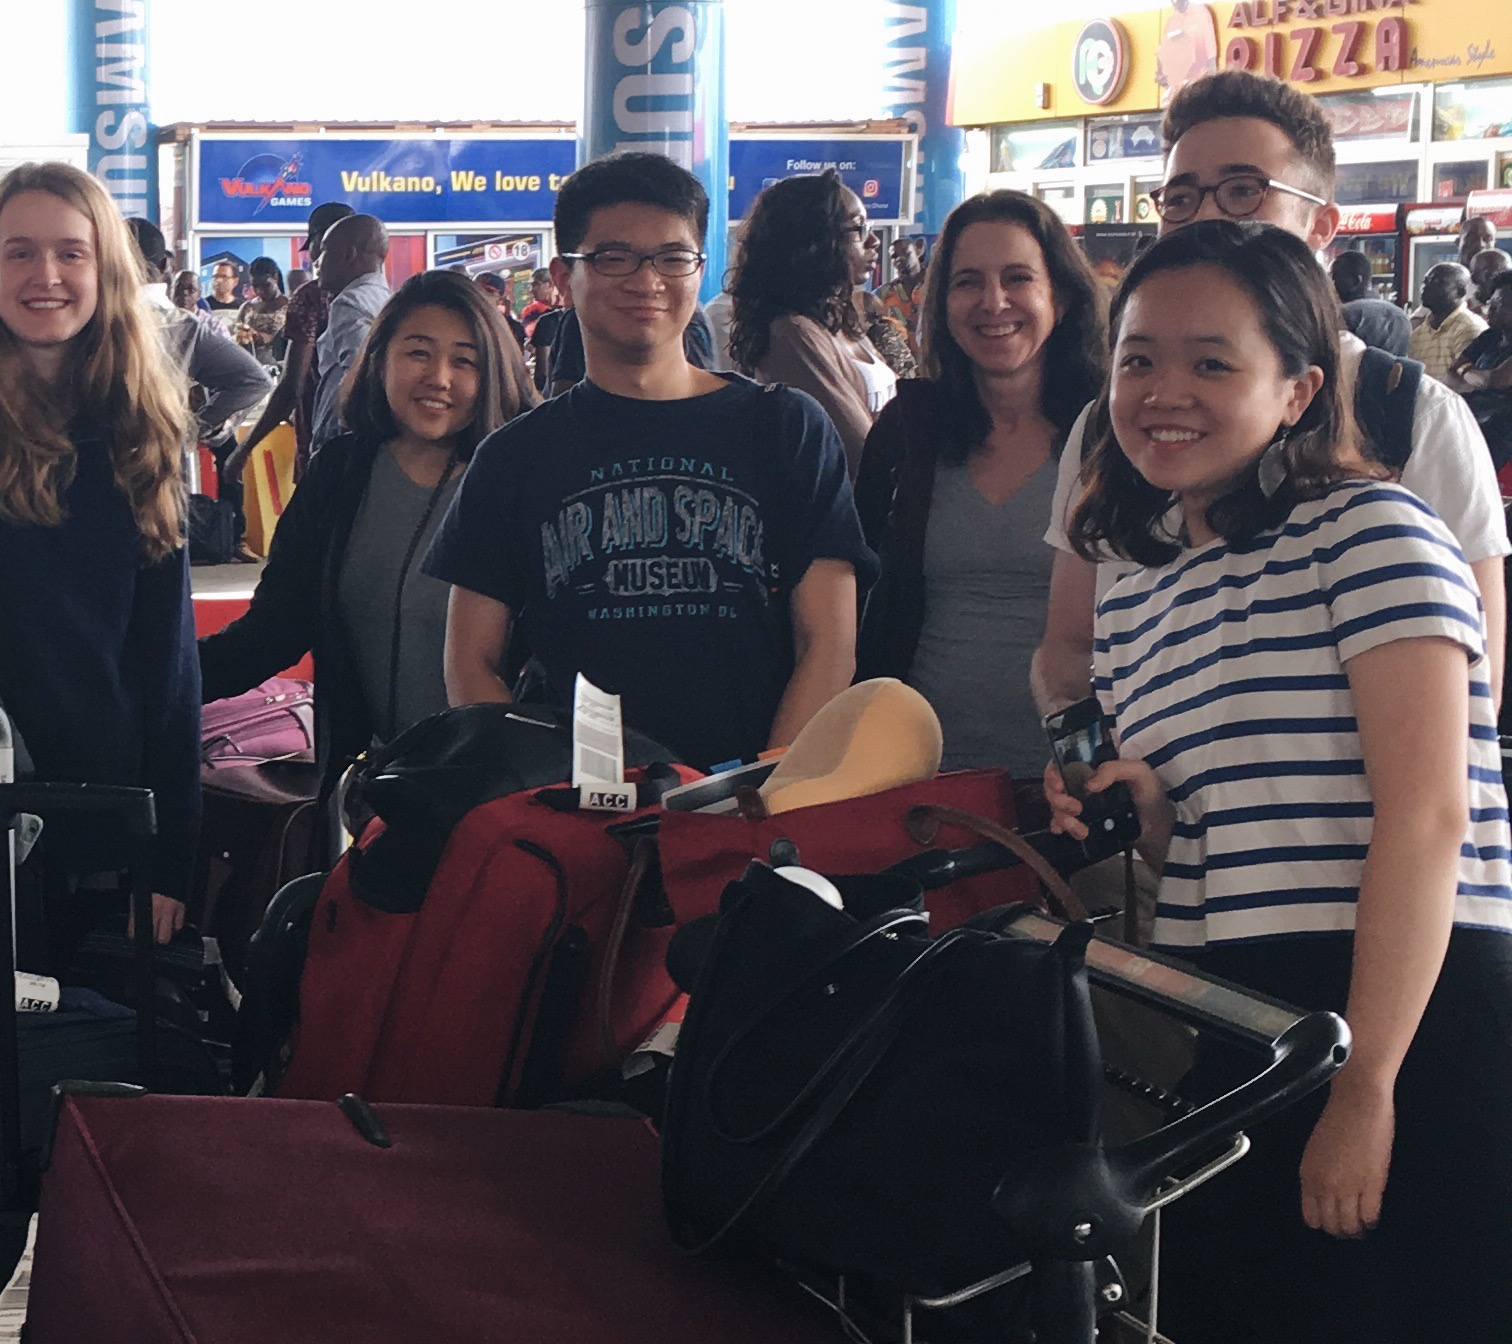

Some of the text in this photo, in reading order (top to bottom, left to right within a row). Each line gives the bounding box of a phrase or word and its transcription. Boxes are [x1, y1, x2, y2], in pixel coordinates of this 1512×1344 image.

[1226, 17, 1410, 81] PIZZA
[786, 159, 822, 170] Follow
[839, 161, 856, 170] on:
[341, 170, 442, 194] Vulkano,
[451, 170, 486, 192] We
[495, 170, 541, 191] love
[270, 197, 312, 207] GAMES
[514, 244, 529, 257] 18
[590, 457, 735, 482] NATIONAL
[541, 501, 594, 600] AIR
[601, 485, 668, 555] AND
[611, 560, 712, 592] MUSEUM
[589, 603, 711, 620] WASHINGTON
[590, 792, 626, 808] ACC
